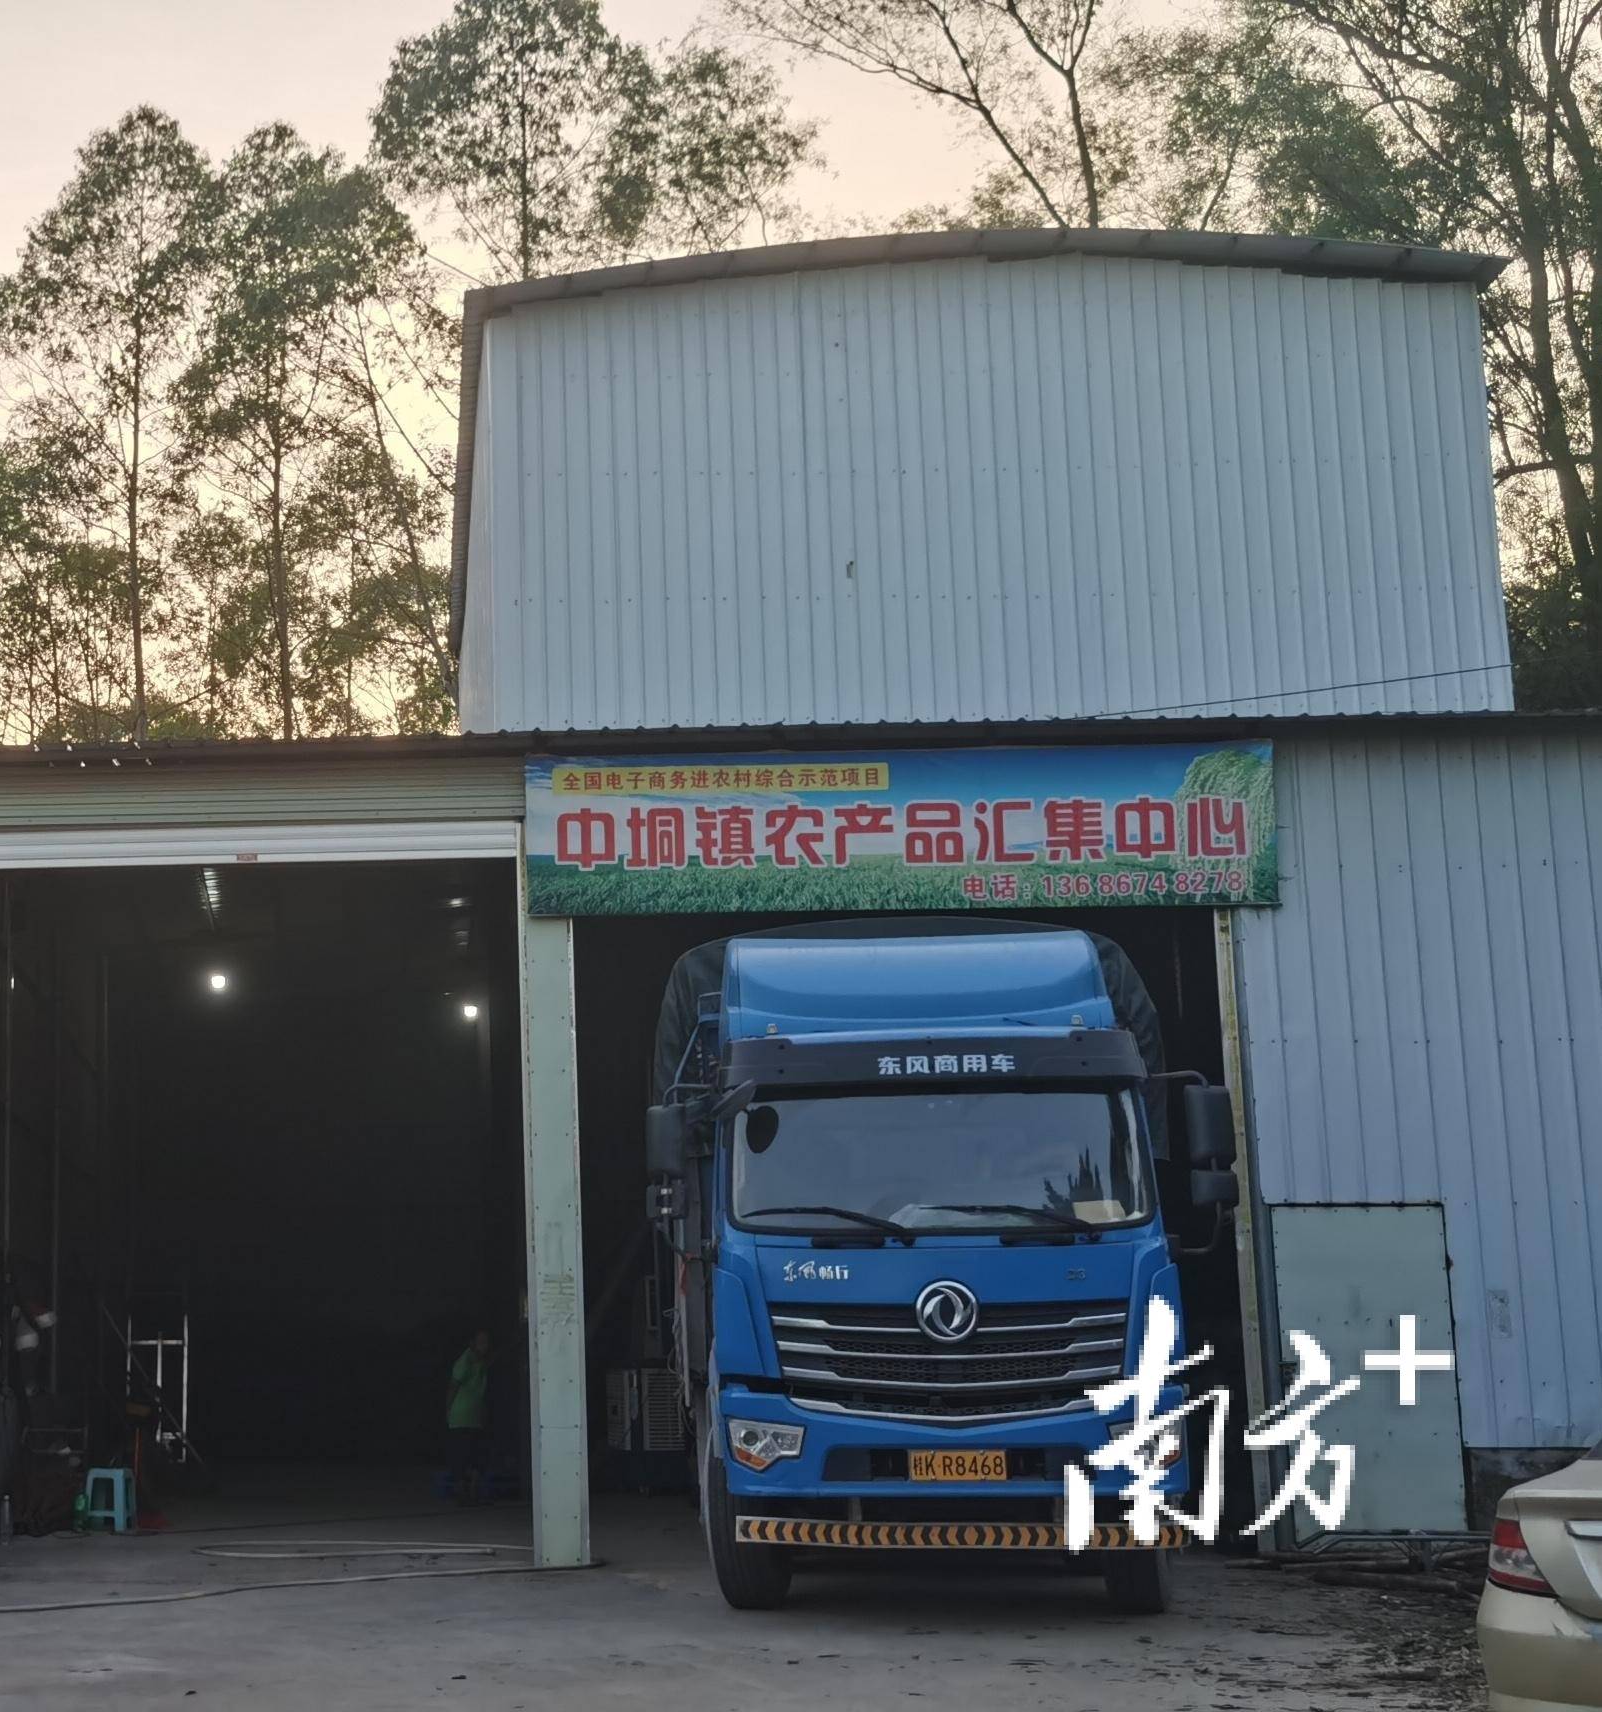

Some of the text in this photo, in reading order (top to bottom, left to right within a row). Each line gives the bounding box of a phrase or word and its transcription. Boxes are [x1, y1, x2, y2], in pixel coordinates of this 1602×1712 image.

[563, 767, 881, 791] 全国电子商务进农村综合示范项目
[555, 795, 1249, 872] 中垌镇农产品汇集中心
[877, 1054, 1016, 1075] 东风商用车
